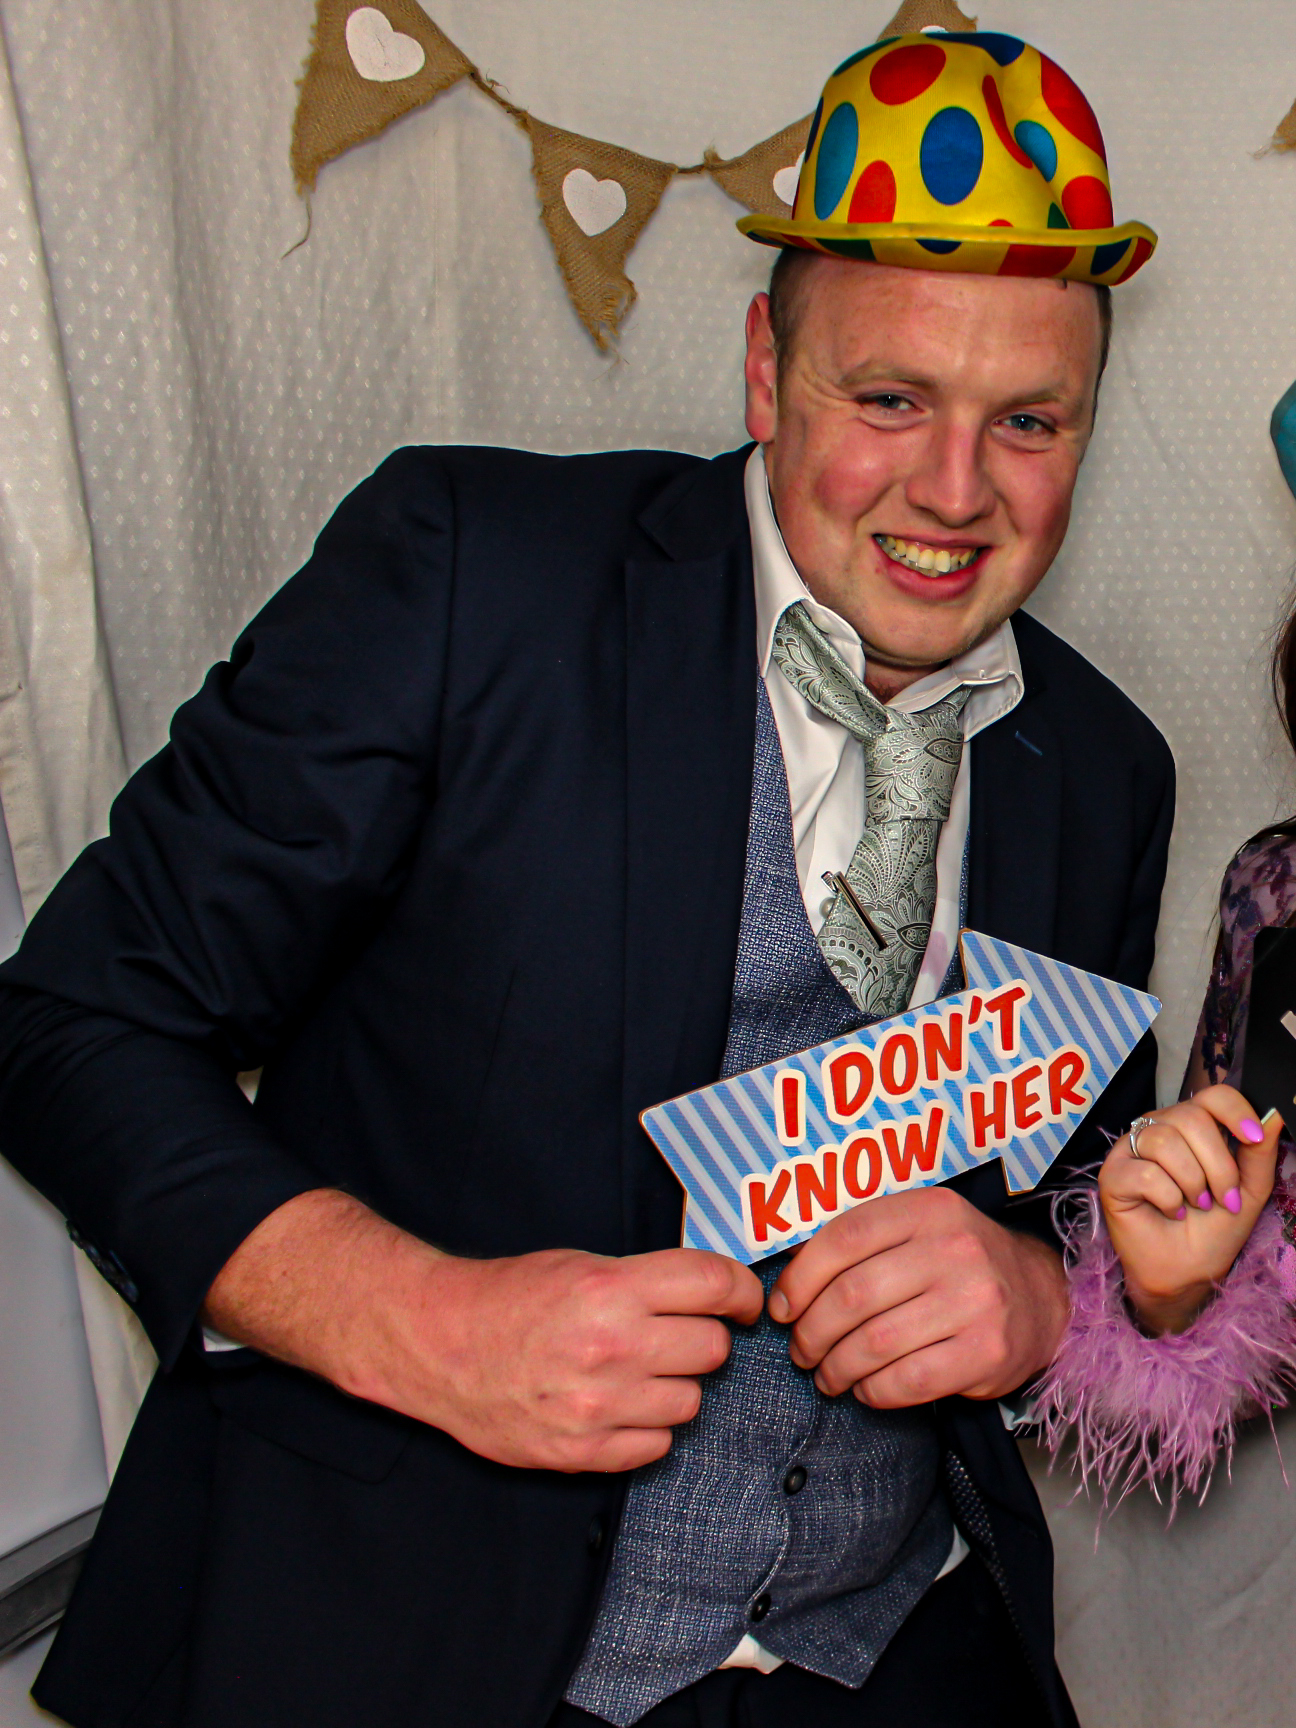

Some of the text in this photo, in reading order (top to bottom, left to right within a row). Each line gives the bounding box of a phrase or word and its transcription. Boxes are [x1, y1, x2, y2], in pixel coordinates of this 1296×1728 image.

[746, 1049, 1088, 1244] KNOW HER
[779, 985, 1027, 1142] I DON'T
